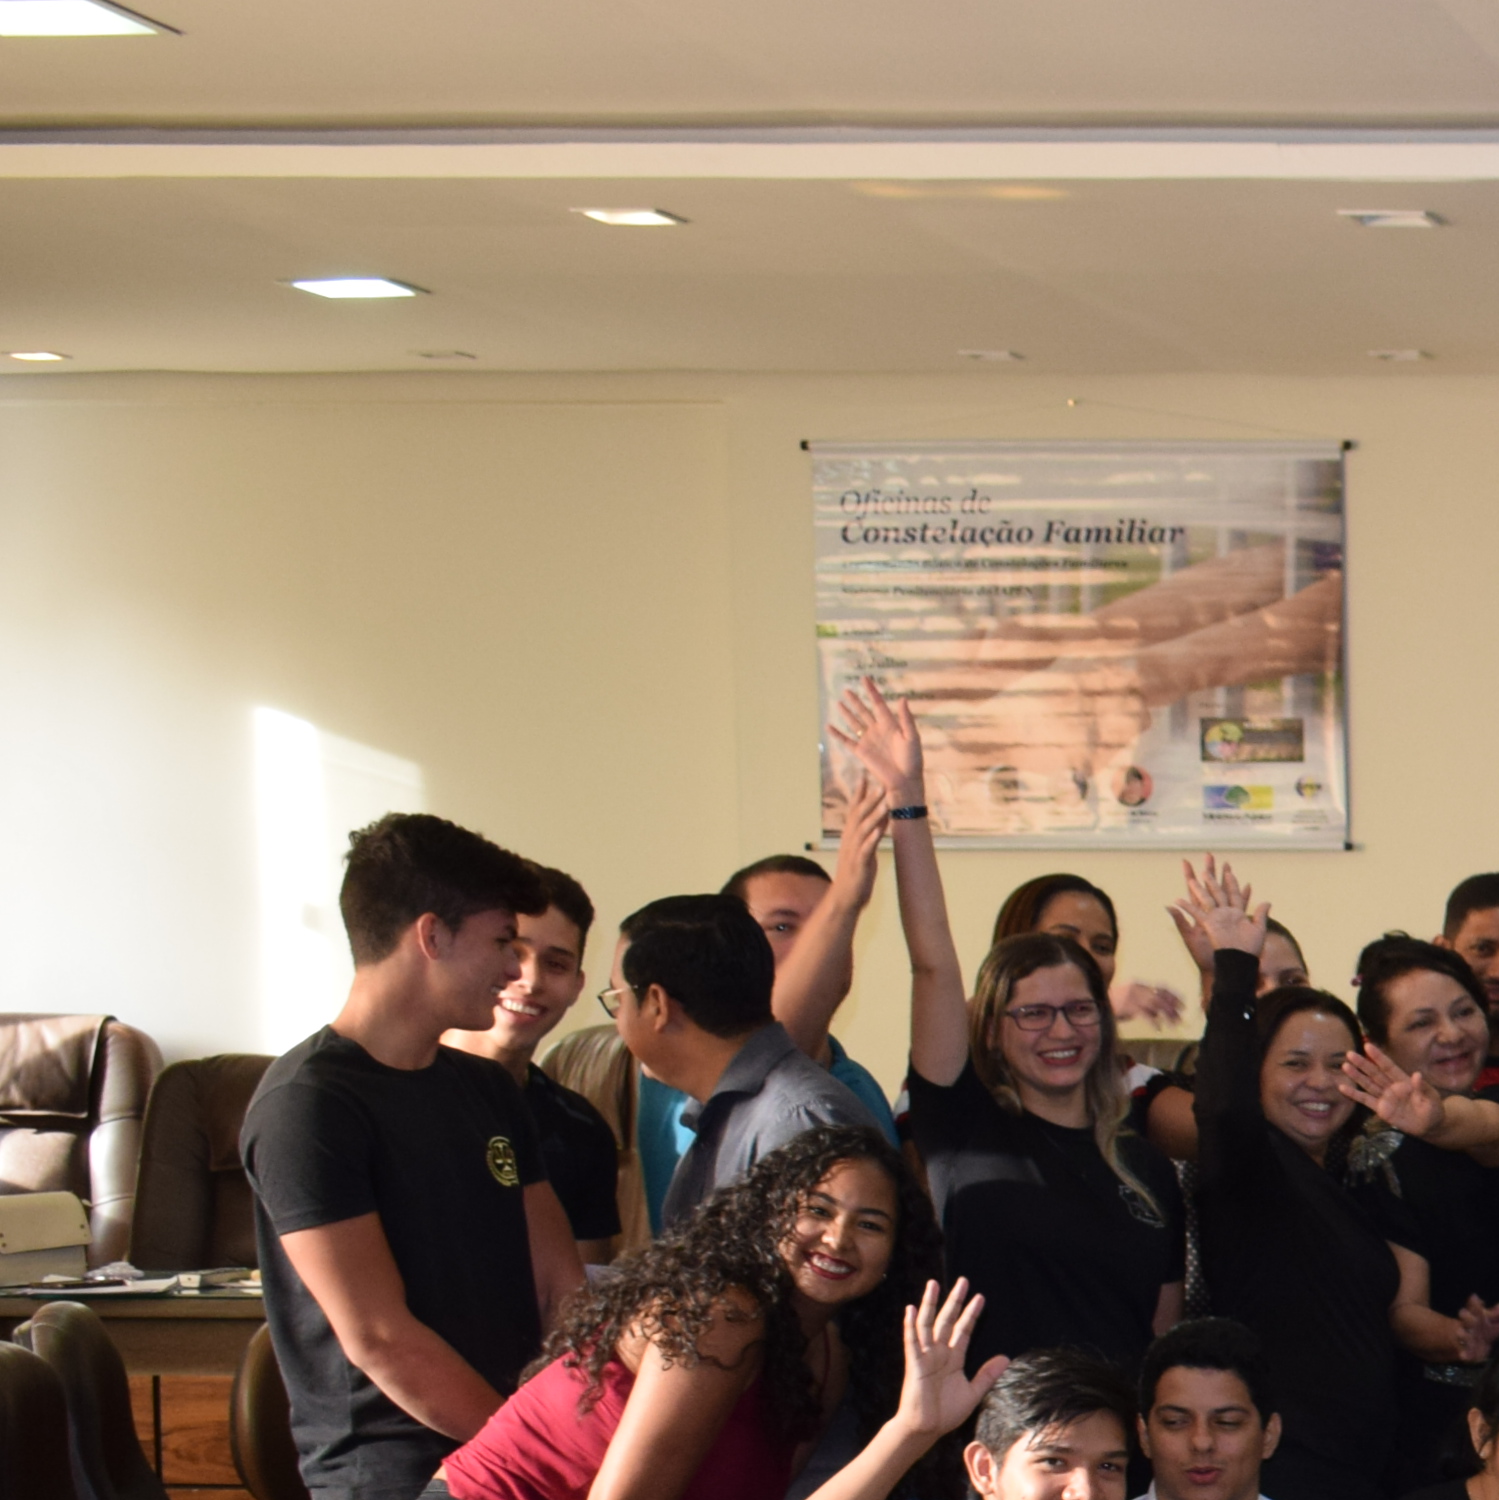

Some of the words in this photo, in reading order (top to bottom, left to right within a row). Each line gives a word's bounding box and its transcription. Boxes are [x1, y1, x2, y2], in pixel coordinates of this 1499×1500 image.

[840, 489, 952, 519] Oficinas
[960, 488, 992, 514] de
[840, 519, 1034, 547] Constelação
[1043, 519, 1185, 545] Familiar
